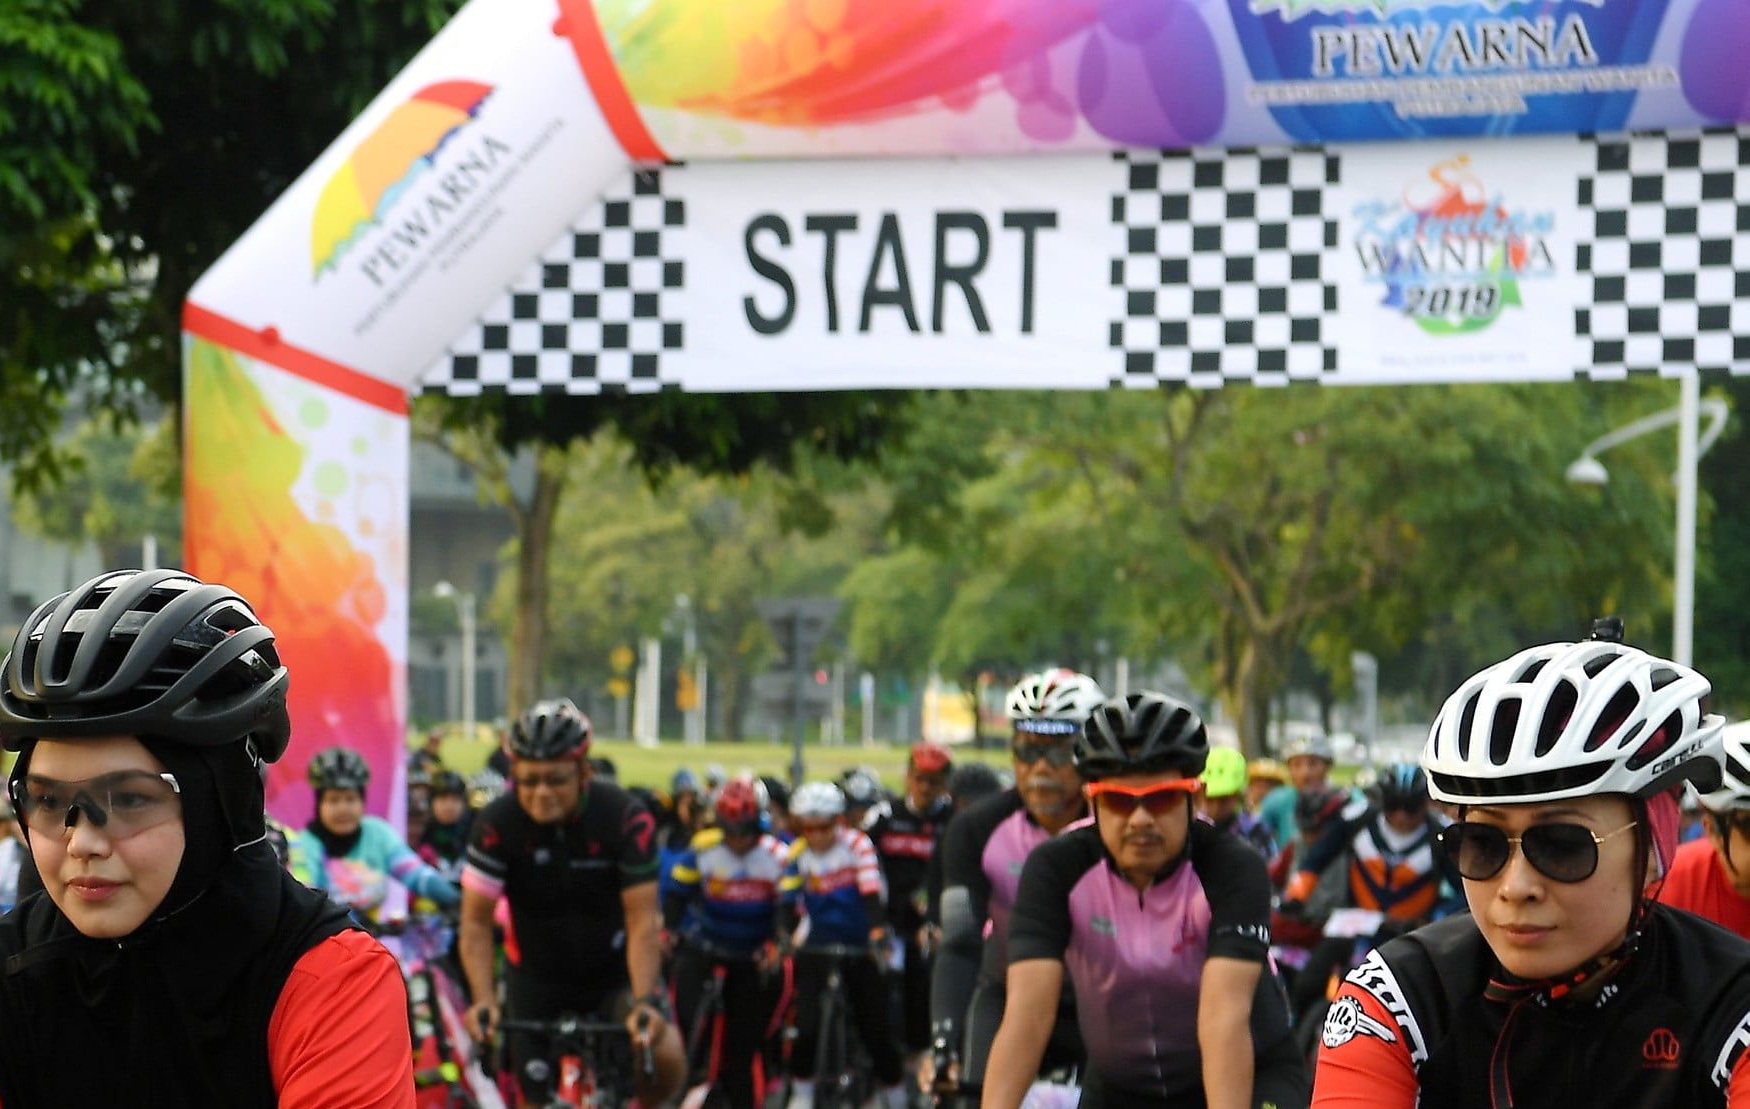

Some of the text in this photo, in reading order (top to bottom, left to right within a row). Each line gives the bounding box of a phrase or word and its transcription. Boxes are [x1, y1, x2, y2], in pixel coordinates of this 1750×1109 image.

[1315, 15, 1596, 76] PEWARNA
[360, 136, 509, 286] PEWARNA
[743, 210, 1058, 335] START
[1404, 286, 1497, 317] 2019
